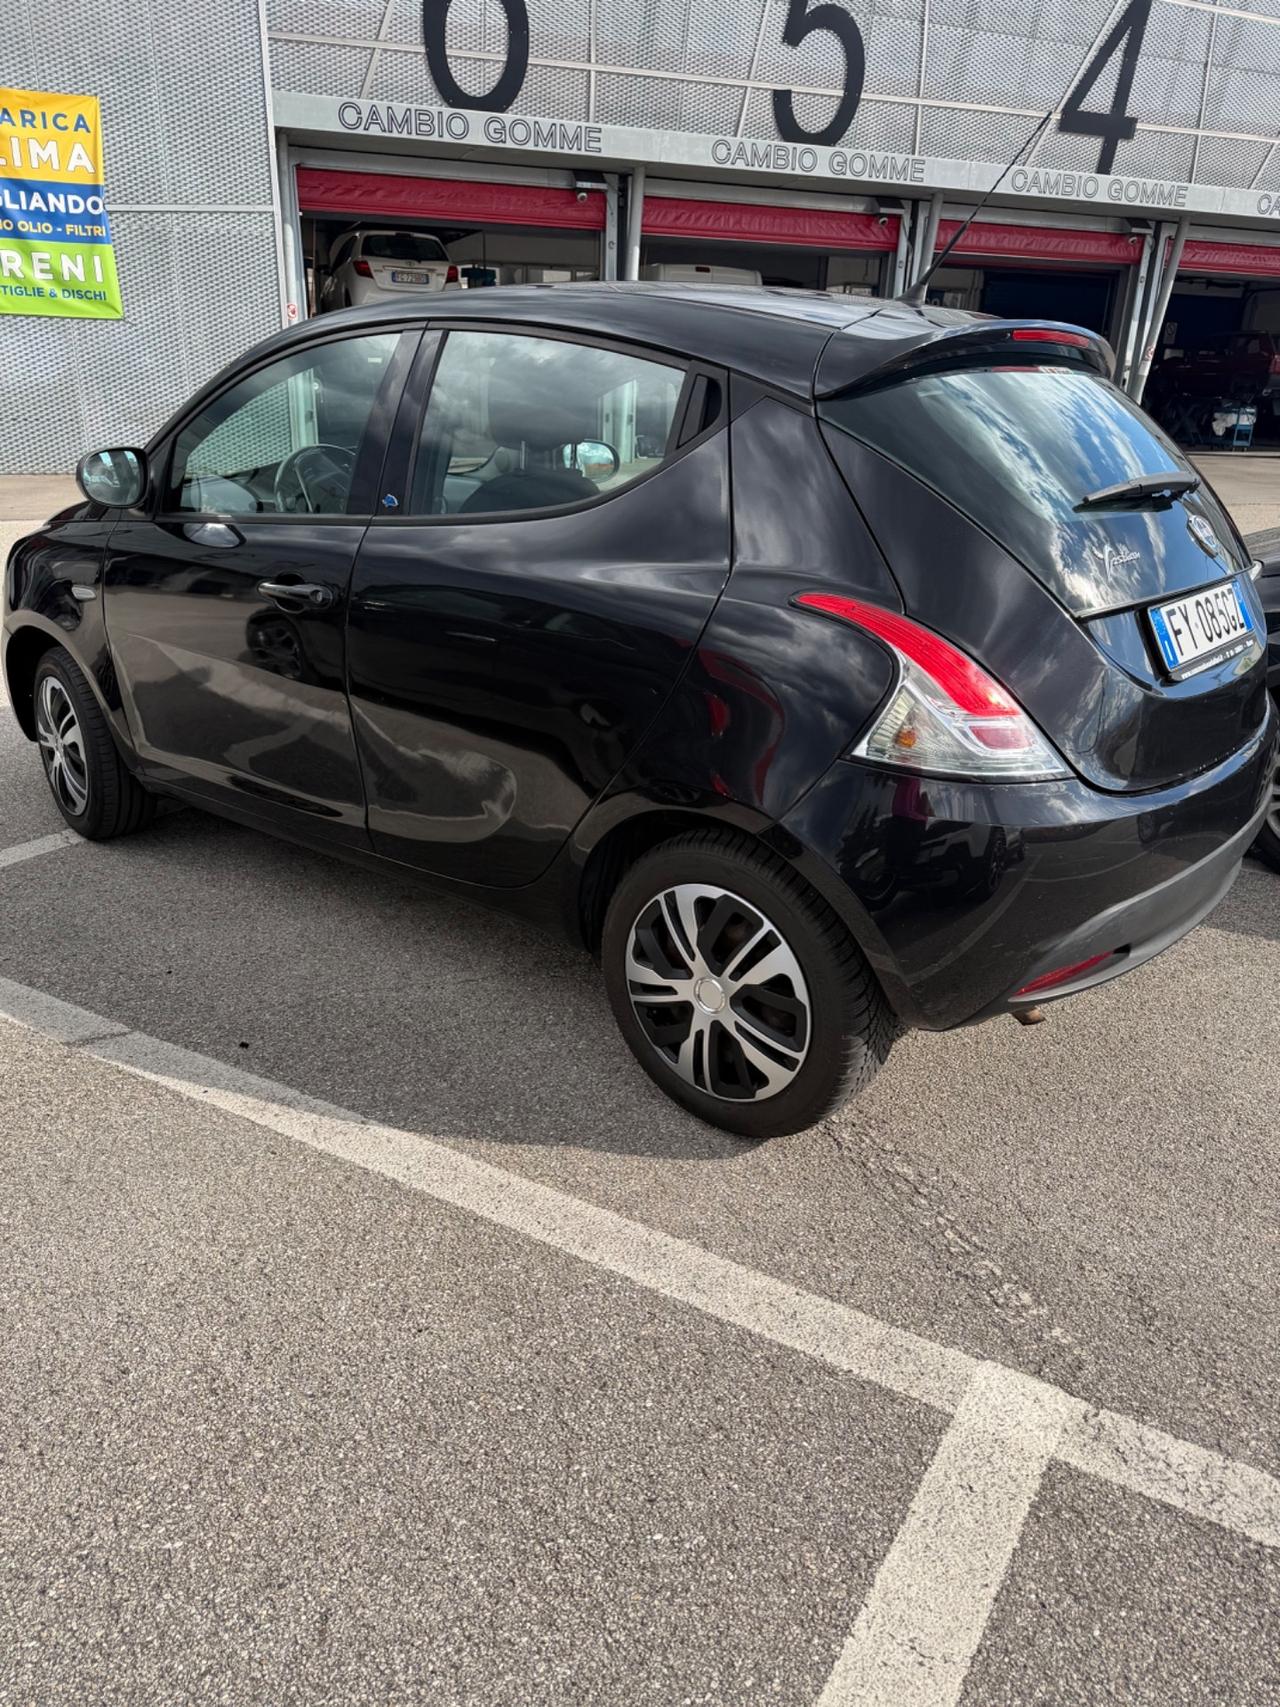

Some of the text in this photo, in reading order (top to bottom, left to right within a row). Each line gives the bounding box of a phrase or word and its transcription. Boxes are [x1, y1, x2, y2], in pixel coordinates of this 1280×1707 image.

[773, 0, 865, 147] 5
[1059, 0, 1152, 175] 4
[0, 107, 91, 133] ARICA
[338, 102, 602, 153] CAMBIO GOMME
[0, 136, 96, 175] IMA
[711, 139, 926, 183] CAMBIO GOMME
[1011, 169, 1188, 208] CAMBIO GOMME
[17, 220, 53, 234] OLIO
[65, 223, 106, 237] FILTRI
[0, 249, 104, 283] RENI
[48, 288, 57, 298] &
[61, 289, 107, 301] DISCHI
